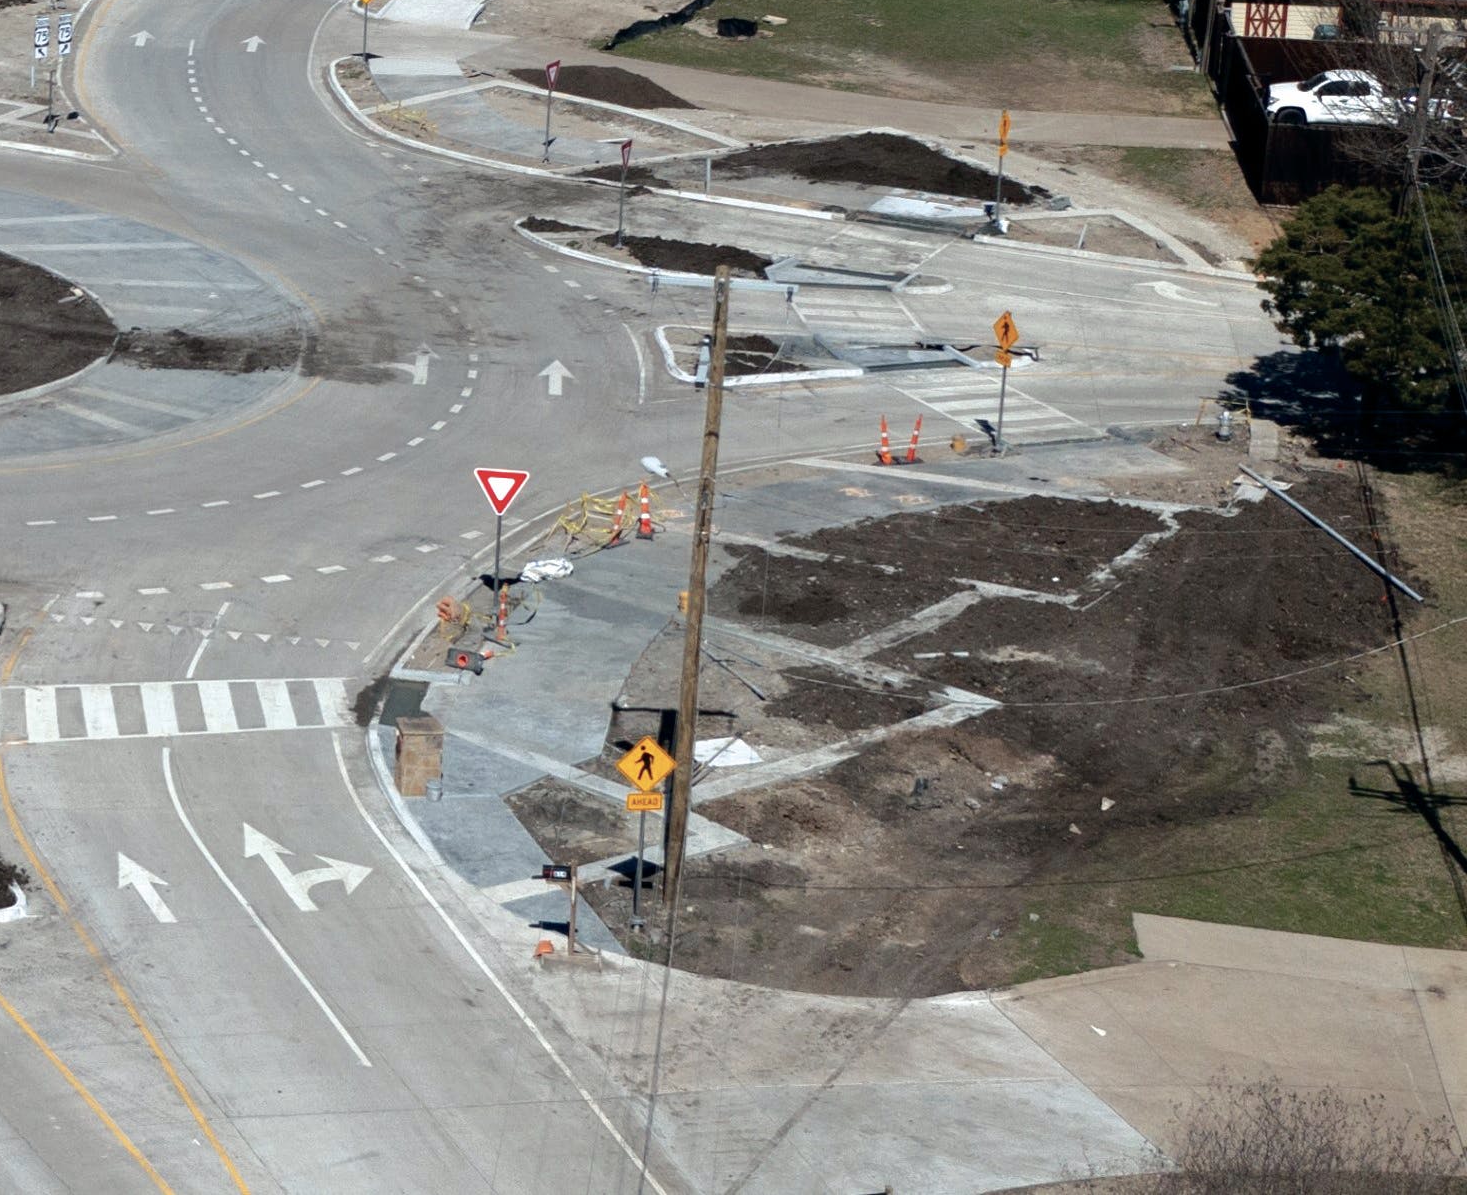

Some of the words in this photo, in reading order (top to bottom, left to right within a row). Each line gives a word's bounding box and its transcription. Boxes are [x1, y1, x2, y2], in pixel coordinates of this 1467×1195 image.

[36, 30, 48, 42] 75
[59, 26, 71, 39] 75
[632, 798, 659, 806] AHEAD
